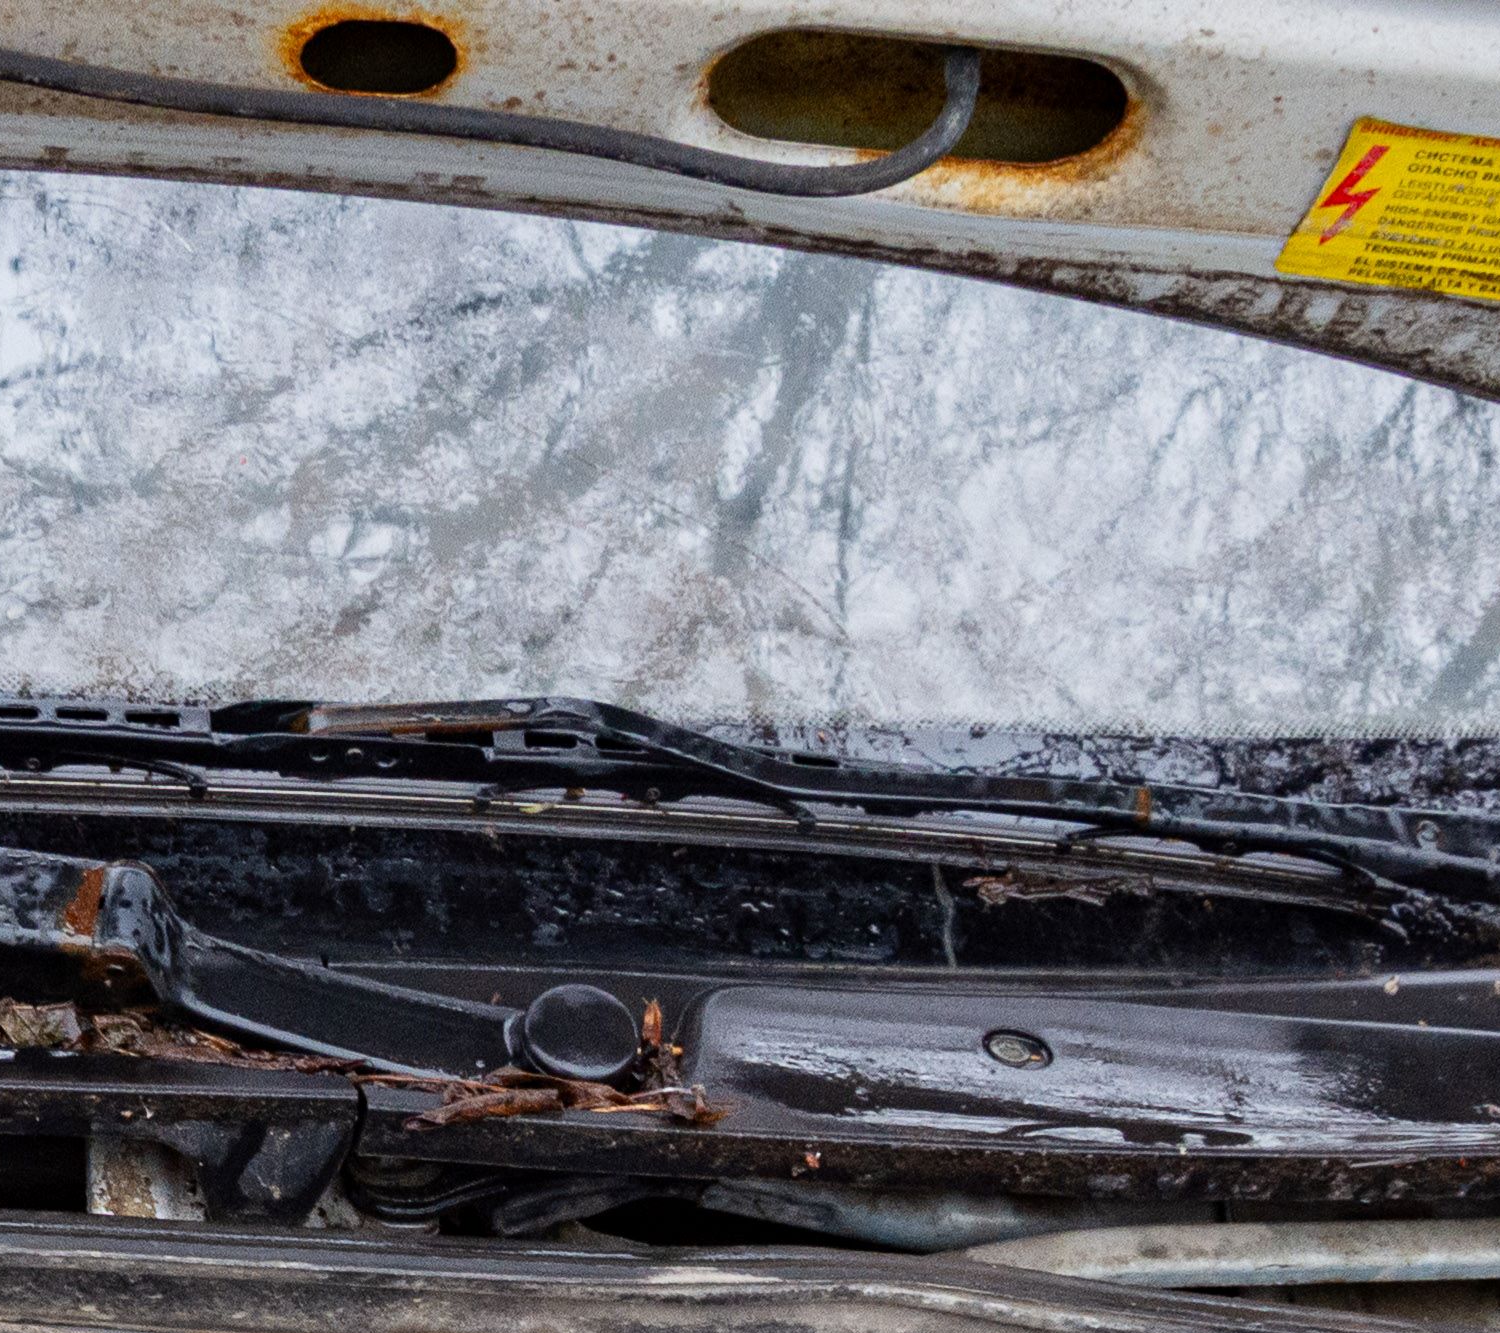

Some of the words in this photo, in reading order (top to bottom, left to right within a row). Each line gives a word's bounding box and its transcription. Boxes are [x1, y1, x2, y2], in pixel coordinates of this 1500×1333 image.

[1412, 149, 1496, 167] СИСТЕМА
[1405, 162, 1480, 180] ОПАСНО
[1376, 215, 1464, 235] DANGEROUS
[1362, 241, 1439, 260] TENSIONS
[1373, 257, 1435, 274] SISTEMA
[1427, 277, 1463, 289] ALTA
